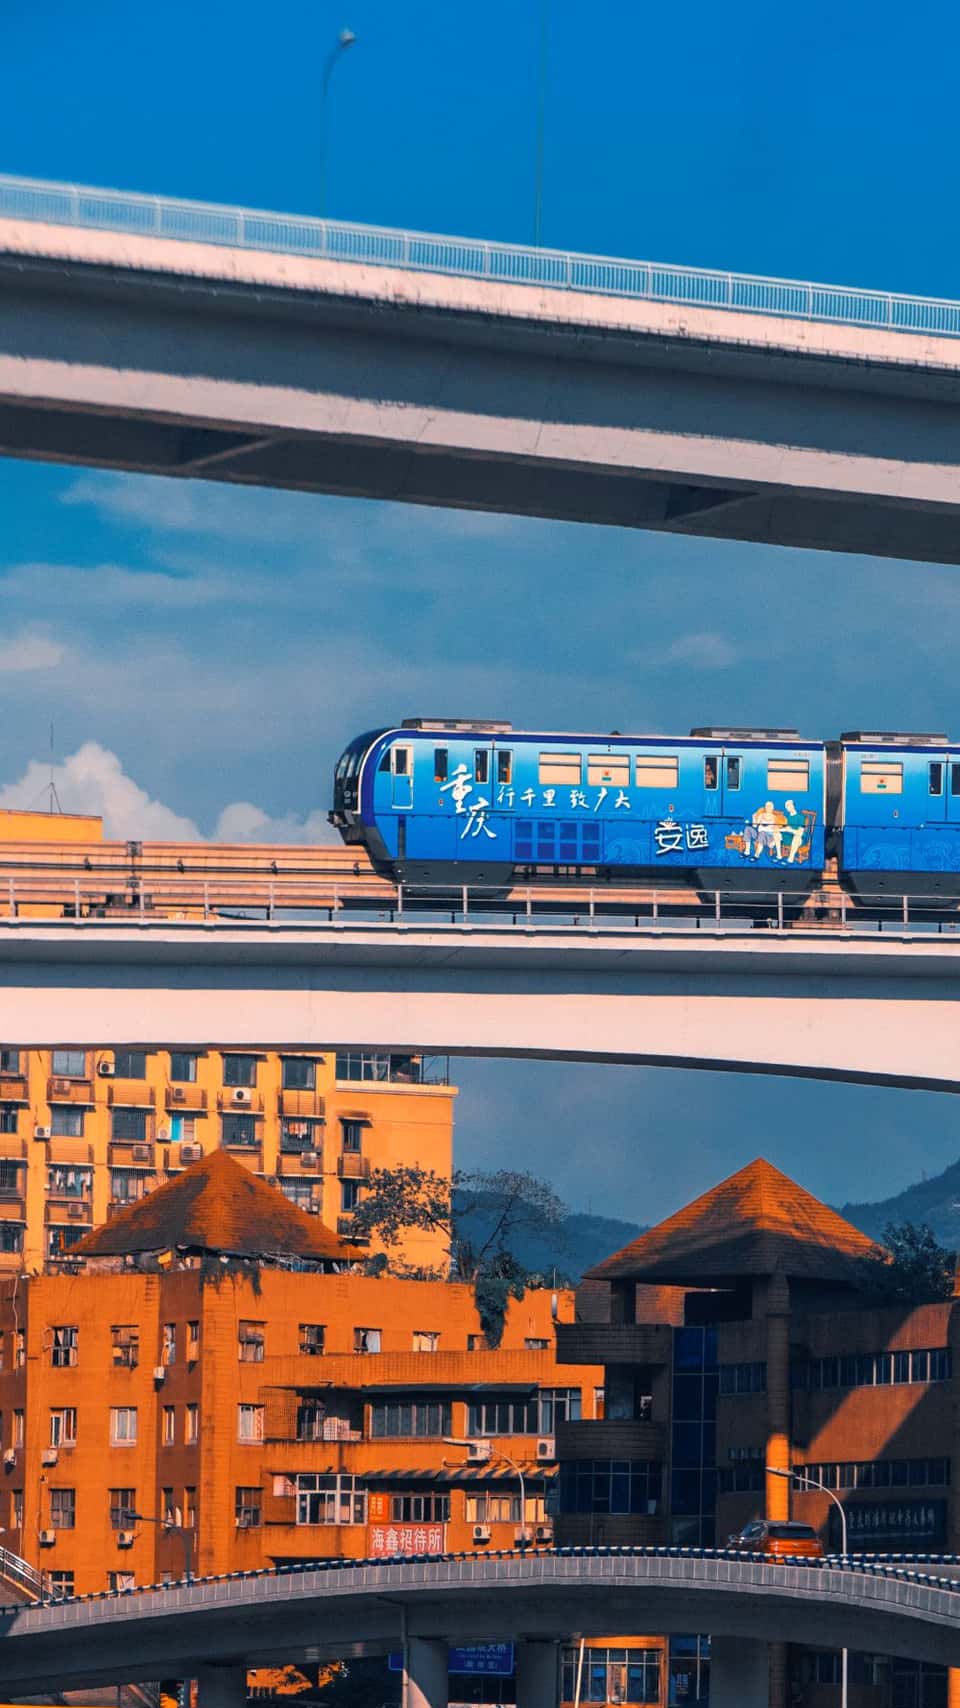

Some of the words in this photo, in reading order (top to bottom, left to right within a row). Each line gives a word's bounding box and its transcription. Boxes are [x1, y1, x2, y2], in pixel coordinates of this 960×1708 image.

[440, 764, 497, 839] 重庆
[497, 786, 556, 808] 行千里
[654, 817, 709, 854] 安逸
